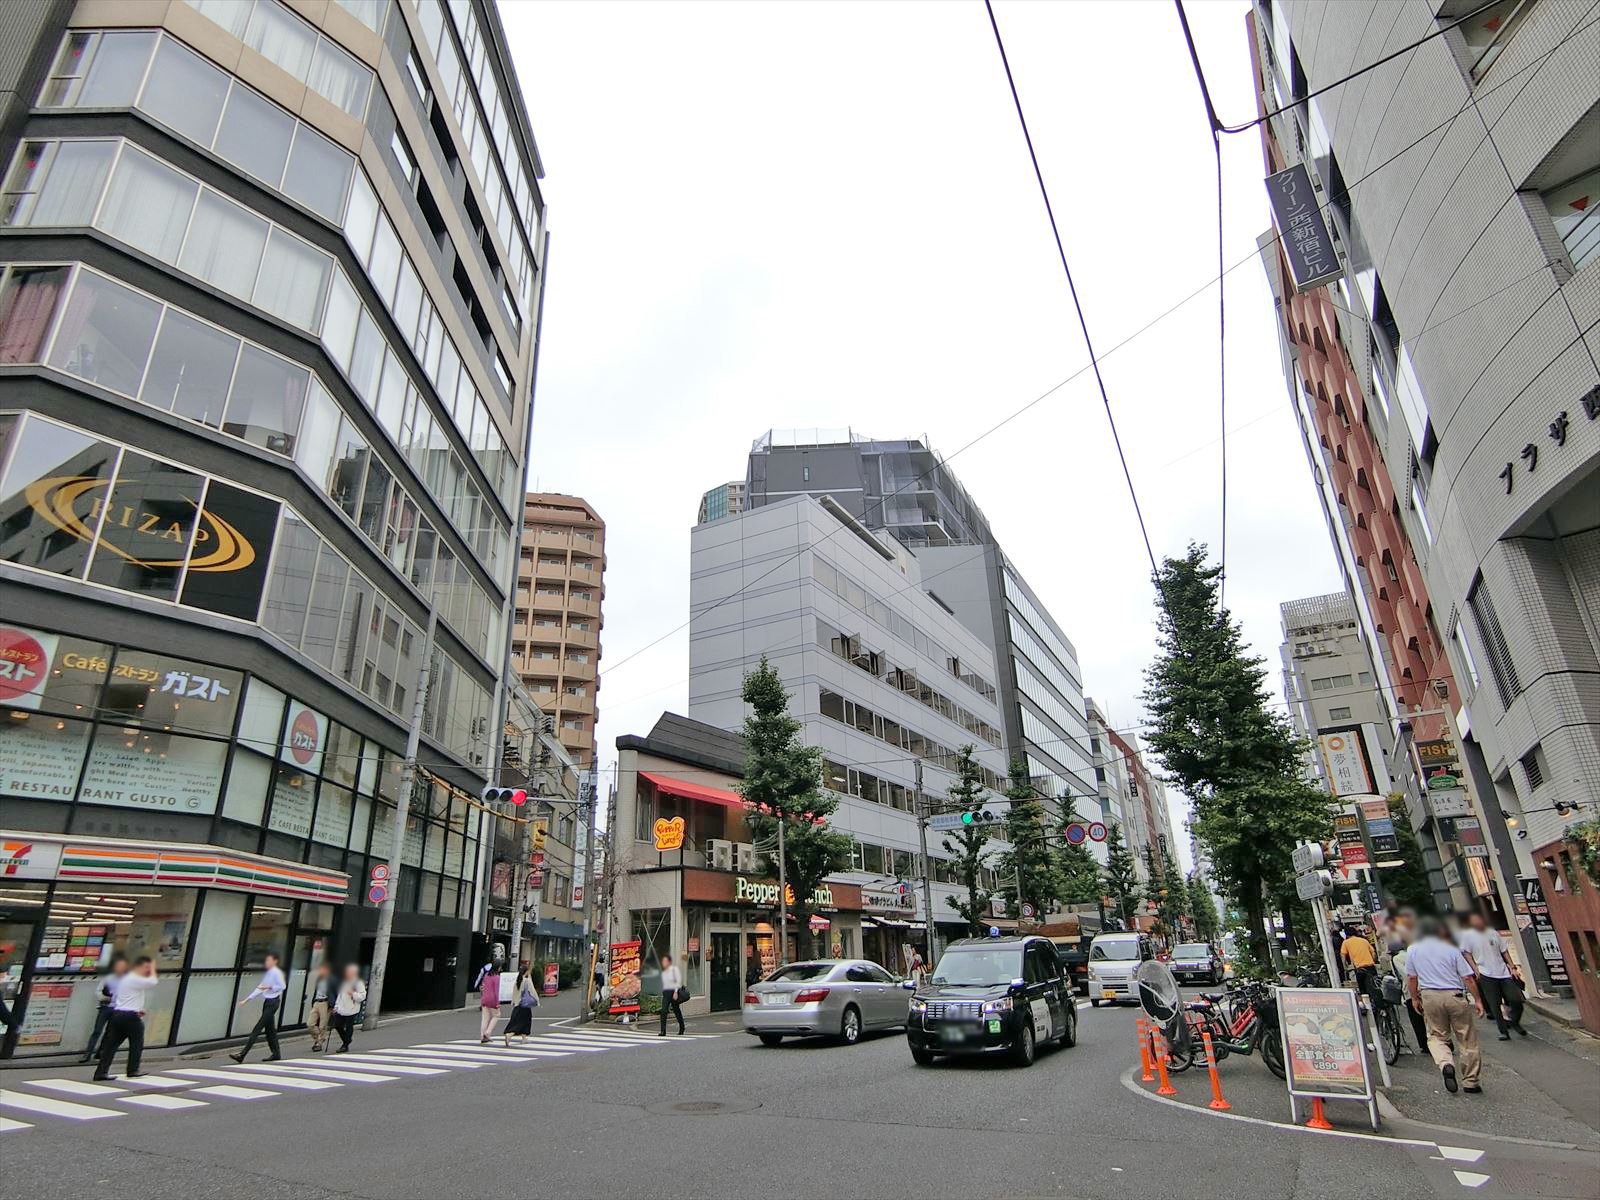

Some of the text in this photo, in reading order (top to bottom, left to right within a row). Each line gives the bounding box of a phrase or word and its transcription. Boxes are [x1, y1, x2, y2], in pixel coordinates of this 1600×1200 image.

[1278, 171, 1330, 279] クリーン西新宿ビル
[89, 498, 210, 549] RIZAP
[63, 652, 108, 673] Café
[160, 671, 231, 702] ガスト
[129, 793, 178, 806] GUSTO
[1093, 827, 1104, 837] 40
[736, 876, 781, 904] Pepper
